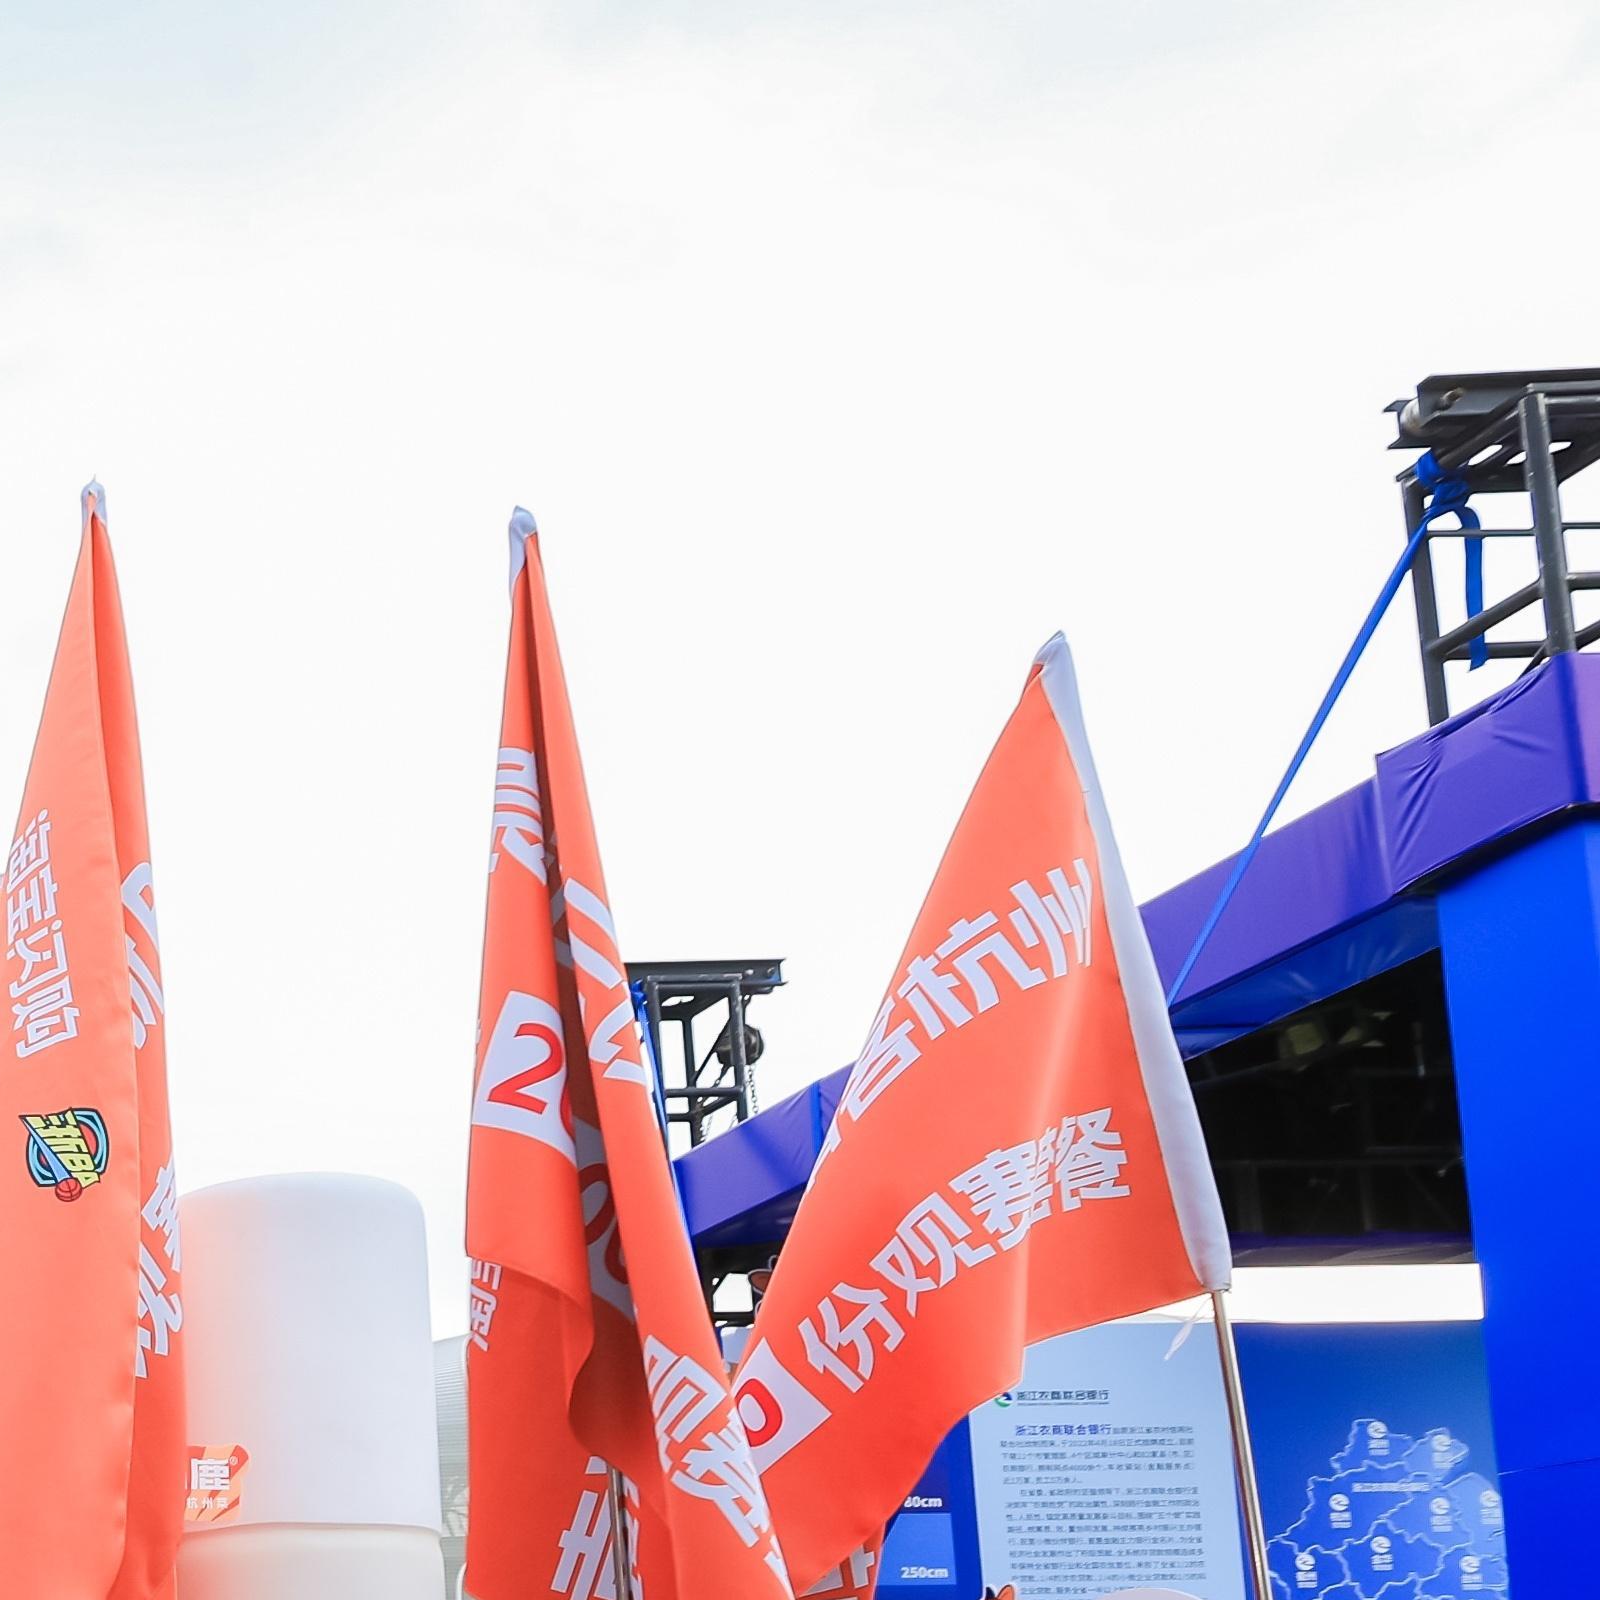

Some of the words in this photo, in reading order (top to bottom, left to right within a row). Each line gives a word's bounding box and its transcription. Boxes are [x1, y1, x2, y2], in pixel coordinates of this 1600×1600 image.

[6, 808, 81, 1058] 淘宝闪购
[900, 1566, 949, 1580] 250cm
